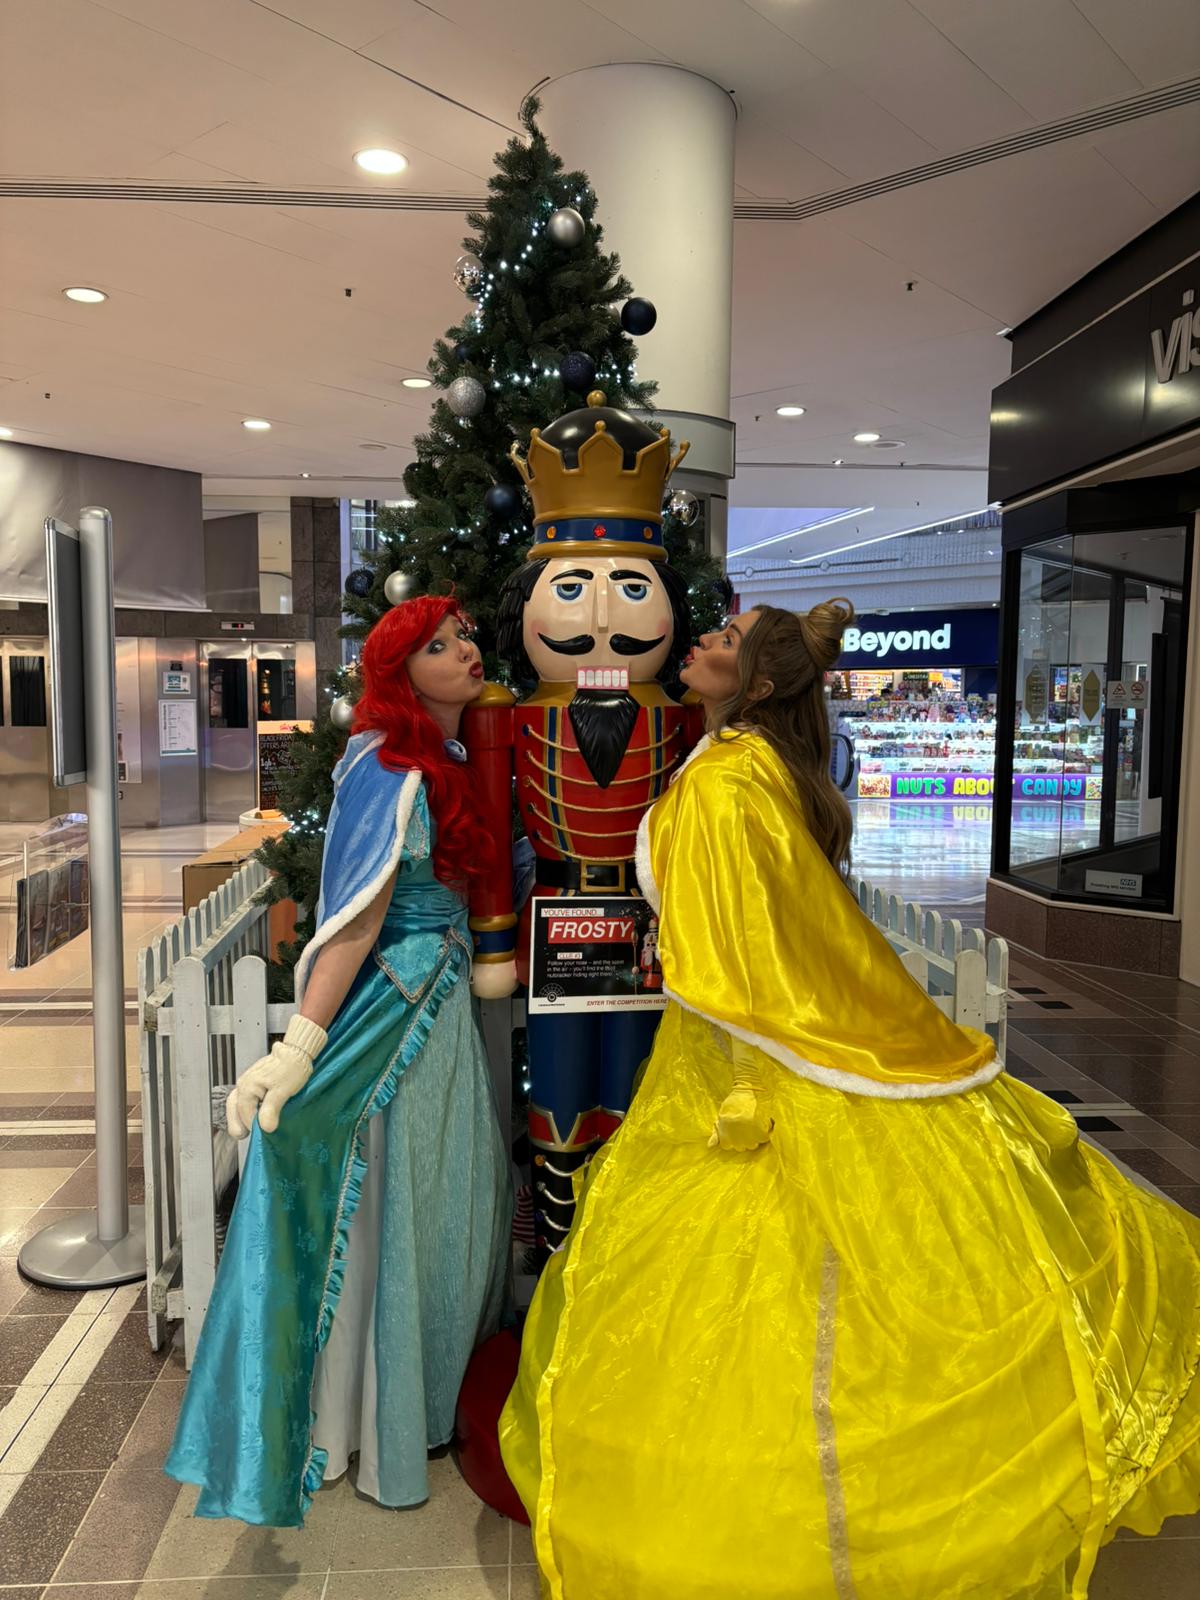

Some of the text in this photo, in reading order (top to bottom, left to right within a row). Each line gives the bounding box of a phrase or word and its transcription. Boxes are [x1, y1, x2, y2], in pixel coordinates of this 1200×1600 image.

[843, 623, 951, 657] Beyond
[896, 777, 1083, 795] NUTS ABO CANDY
[550, 921, 632, 939] FROSTY
